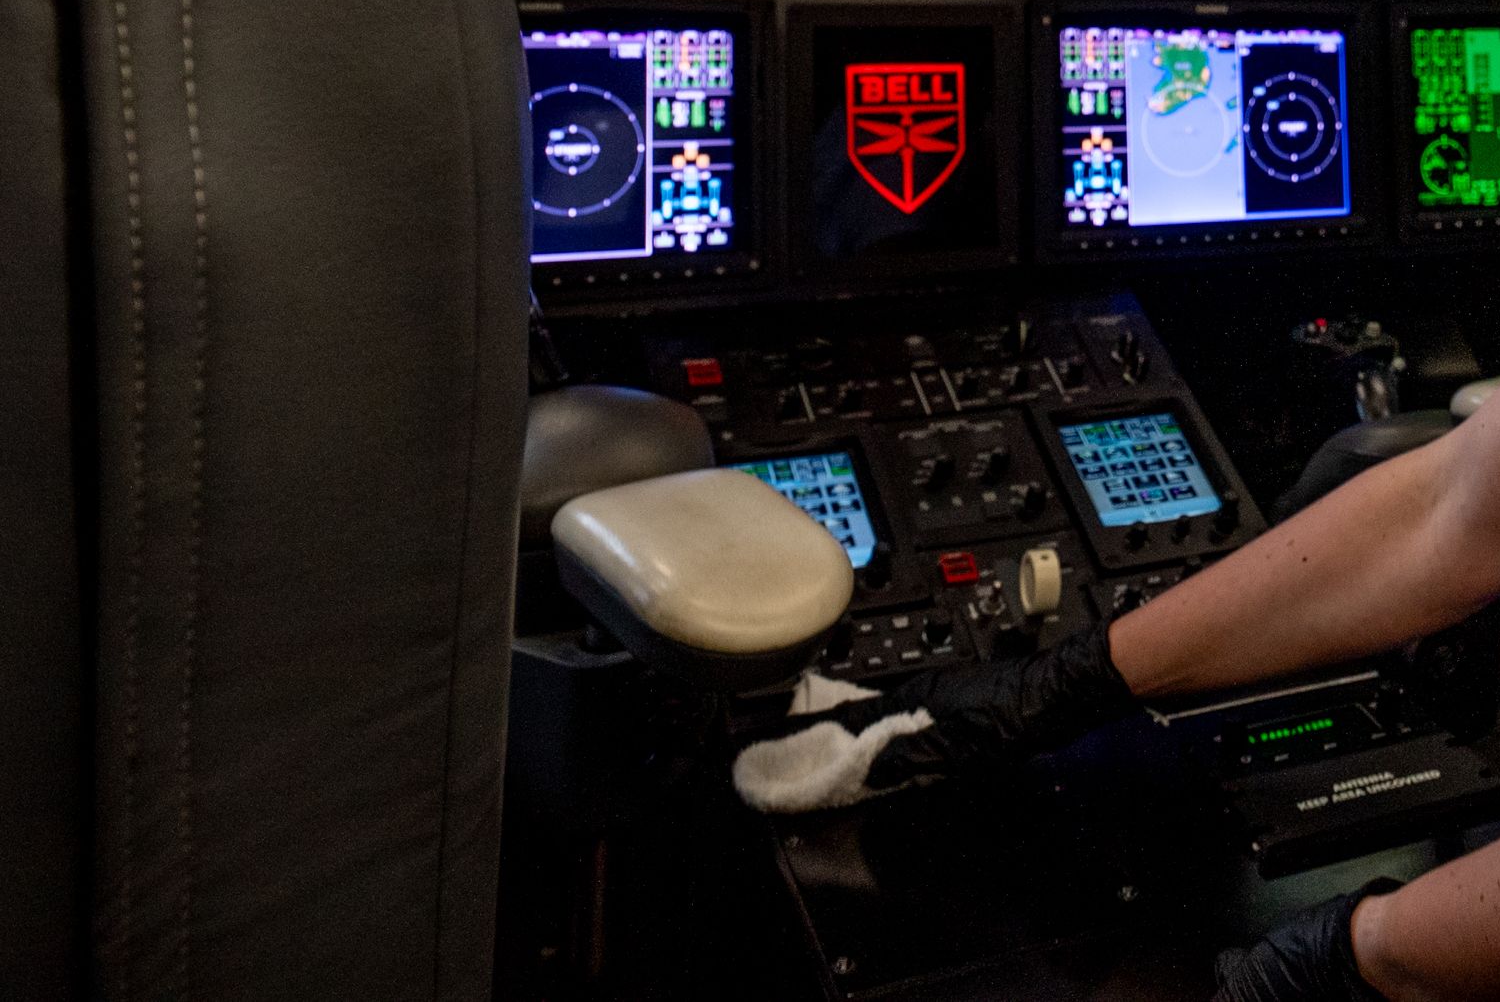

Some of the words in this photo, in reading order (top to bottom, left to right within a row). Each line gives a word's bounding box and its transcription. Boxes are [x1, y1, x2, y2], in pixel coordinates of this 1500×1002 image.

[859, 75, 953, 103] BELL
[1297, 796, 1329, 812] KEEP
[1332, 788, 1366, 803] AREA
[1366, 769, 1441, 794] UNCOVERED
[1333, 771, 1394, 792] ANTENNA
